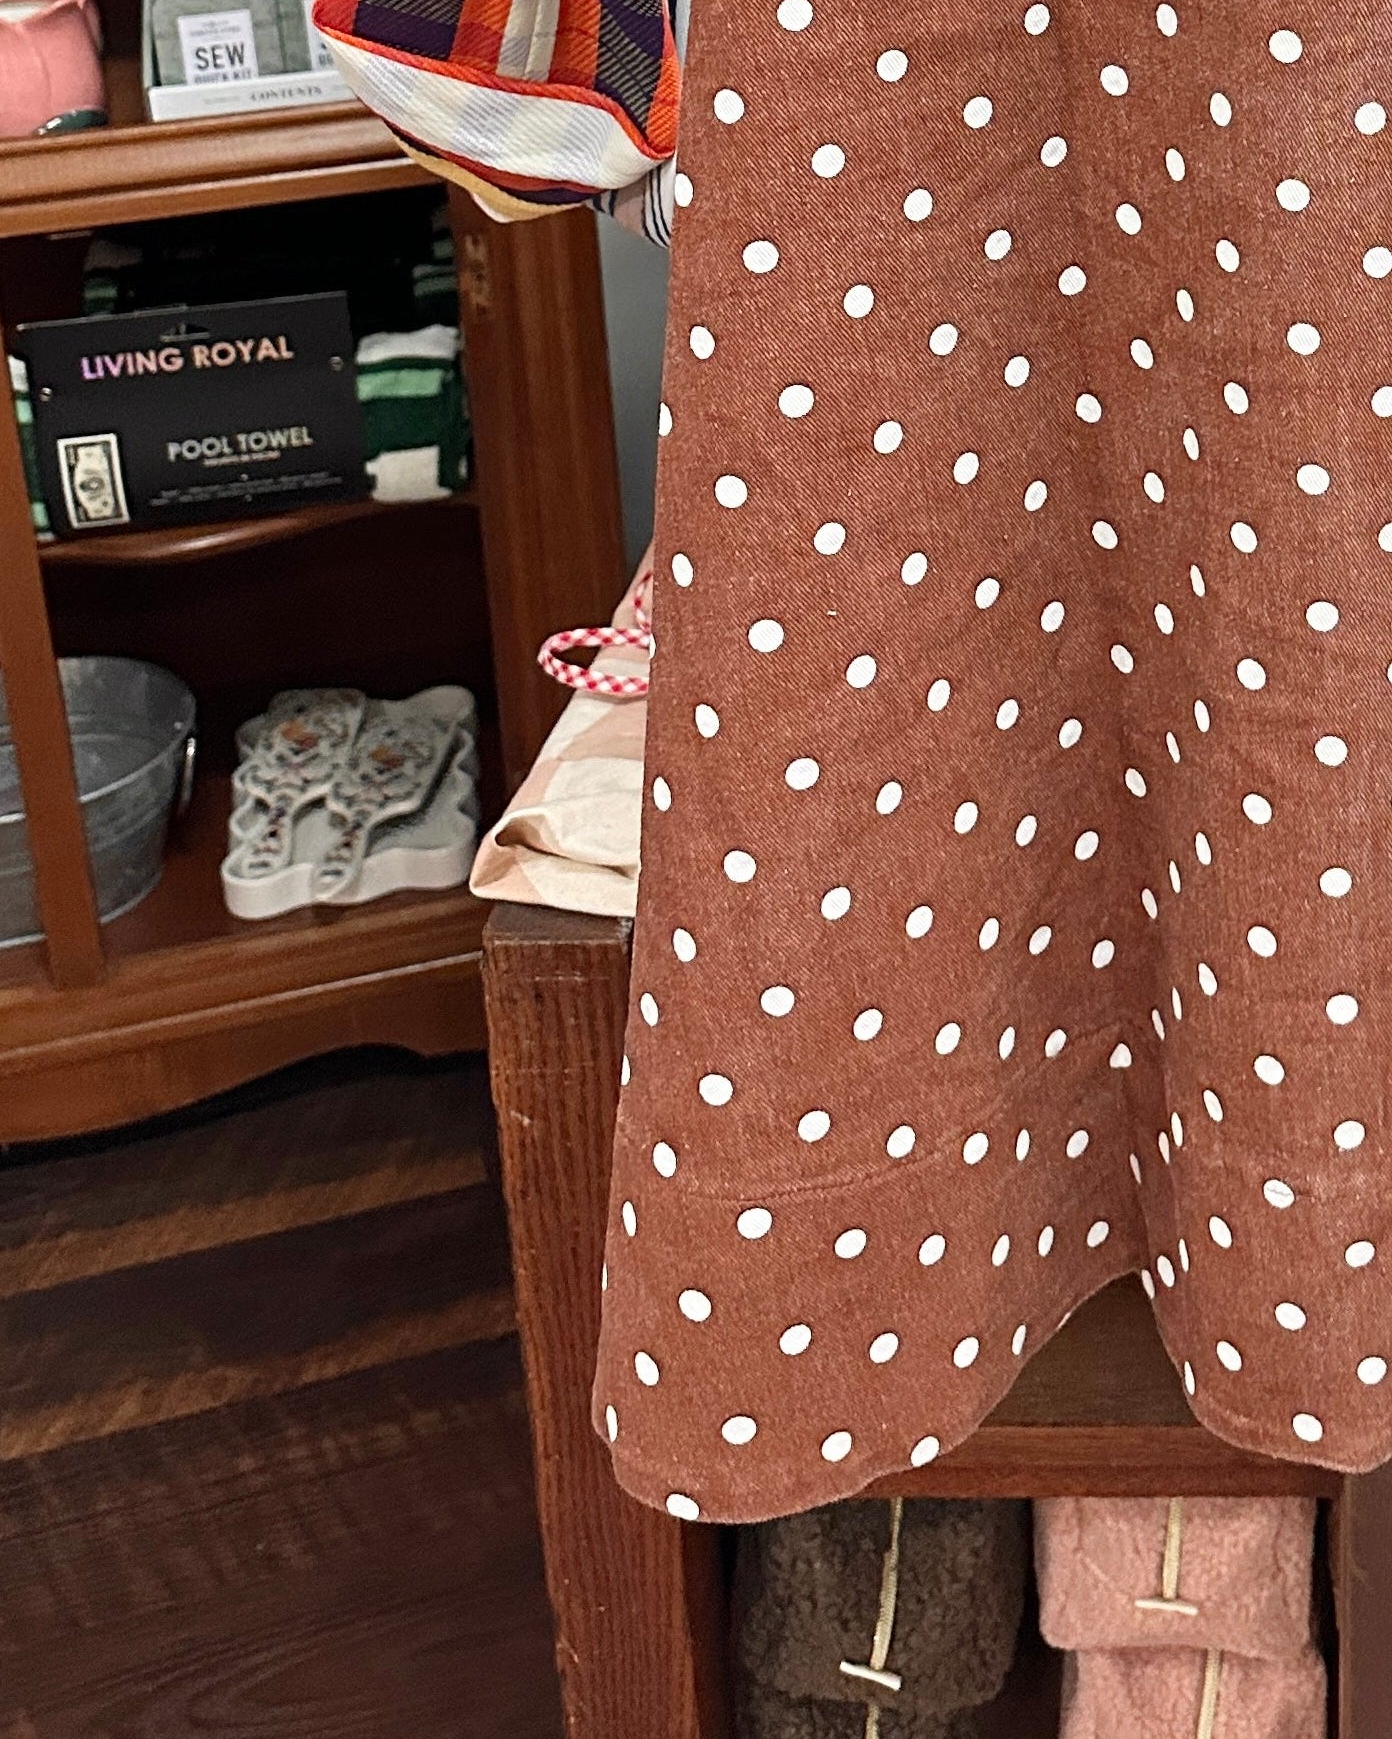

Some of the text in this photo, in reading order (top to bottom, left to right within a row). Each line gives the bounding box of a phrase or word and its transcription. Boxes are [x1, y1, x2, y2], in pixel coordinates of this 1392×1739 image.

[195, 41, 245, 70] SEW
[80, 335, 295, 380] LIVING ROYAL
[166, 436, 232, 461] POOL
[236, 426, 314, 454] TOWEL
